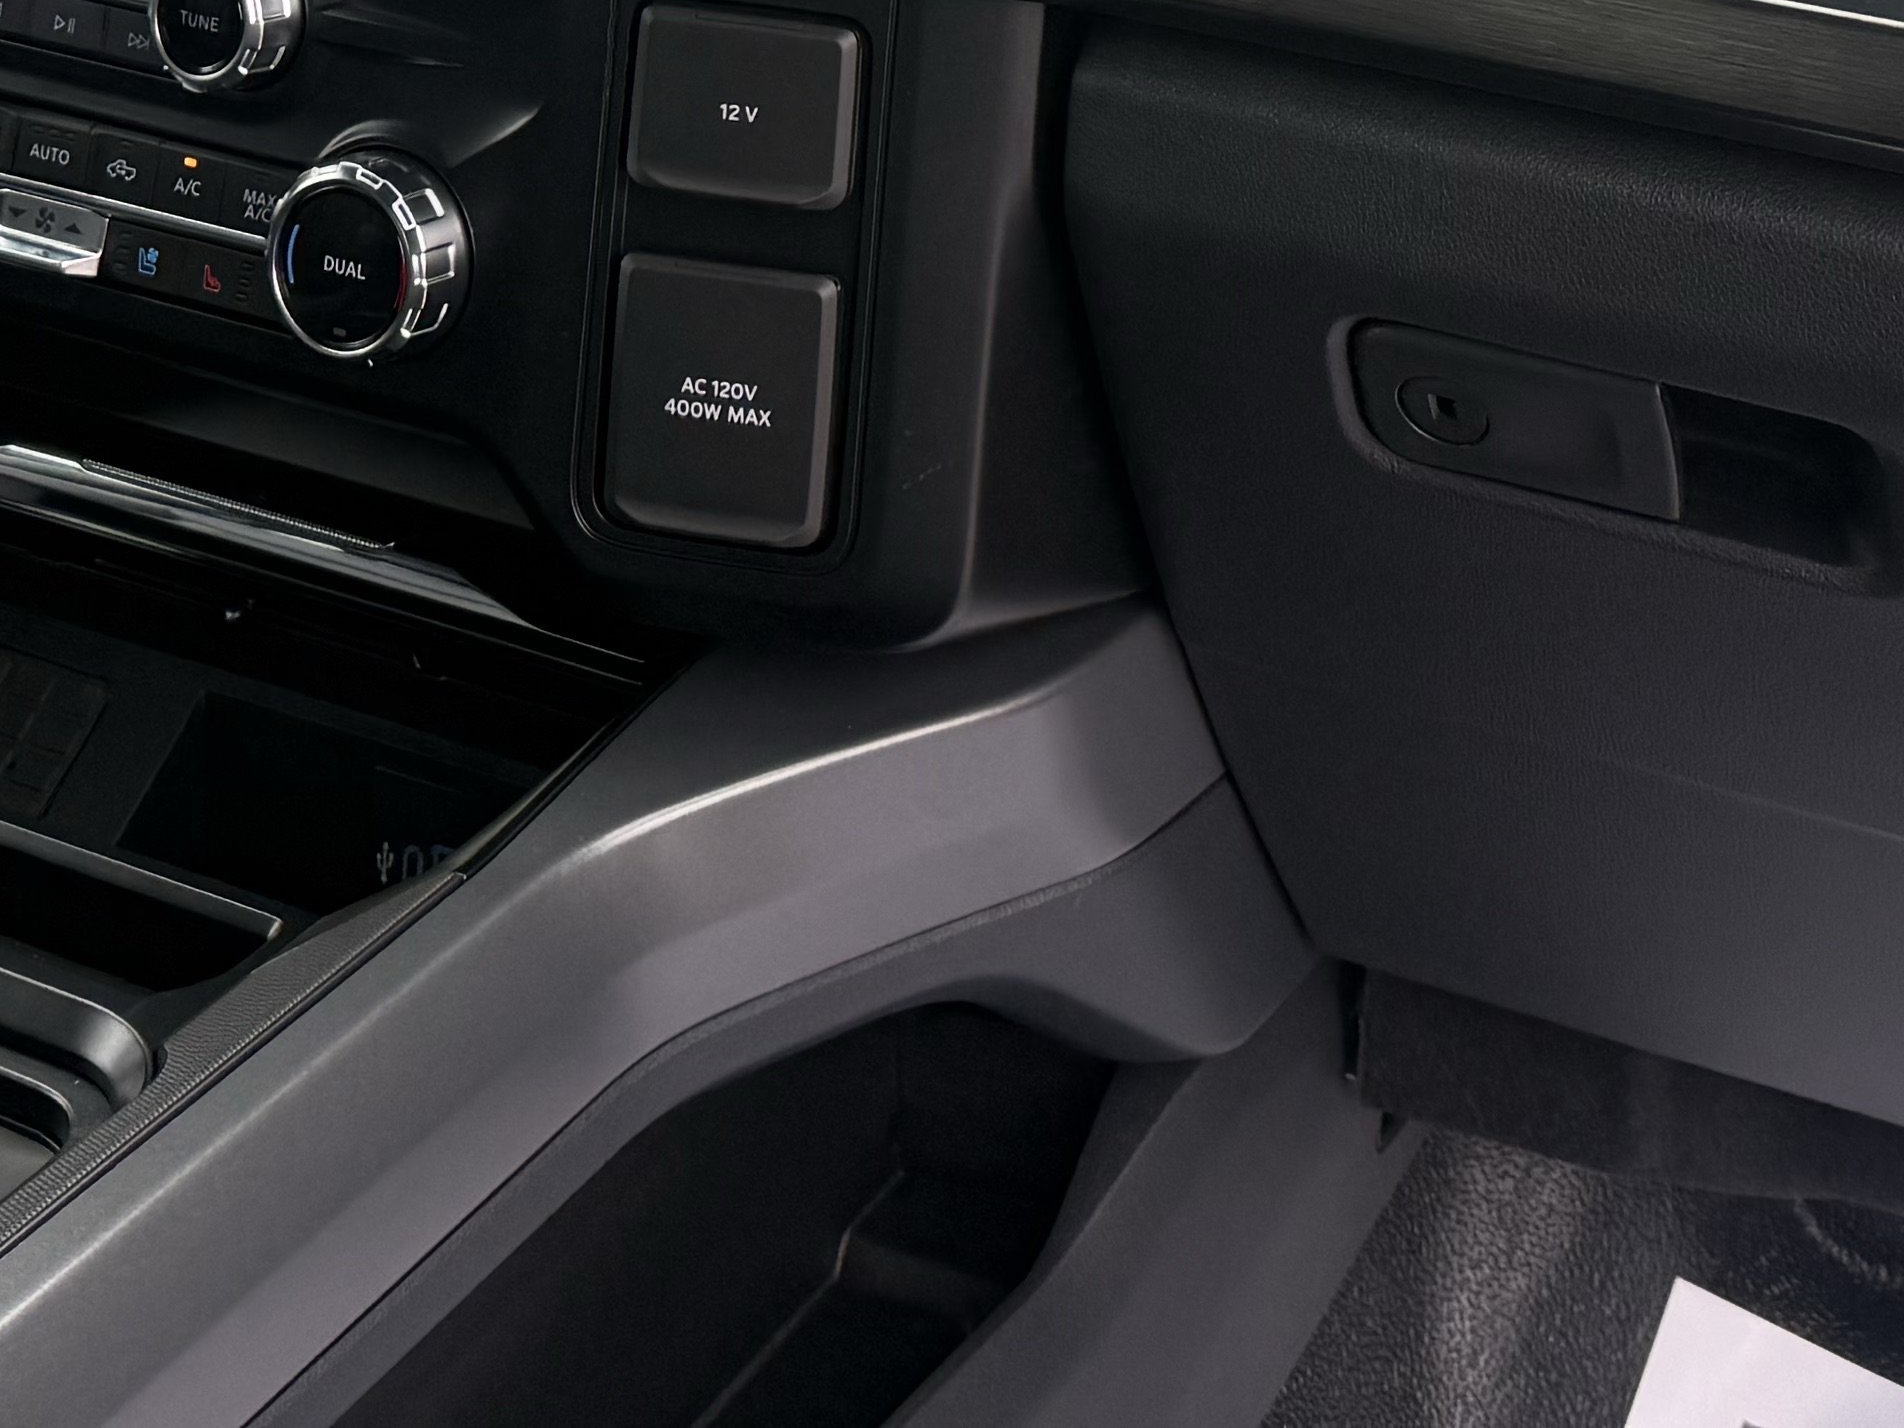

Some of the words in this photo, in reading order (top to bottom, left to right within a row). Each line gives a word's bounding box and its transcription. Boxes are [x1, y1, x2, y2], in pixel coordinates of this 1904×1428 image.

[179, 8, 221, 34] TUNE
[719, 102, 742, 122] 12
[745, 105, 760, 124] V
[28, 142, 72, 168] AUTO
[173, 176, 203, 200] A/C
[242, 188, 279, 211] MAX
[322, 254, 368, 282] DUAL
[680, 376, 707, 396] AC
[711, 379, 758, 403] 120V
[663, 397, 723, 423] 400W
[727, 405, 773, 429] MAX
